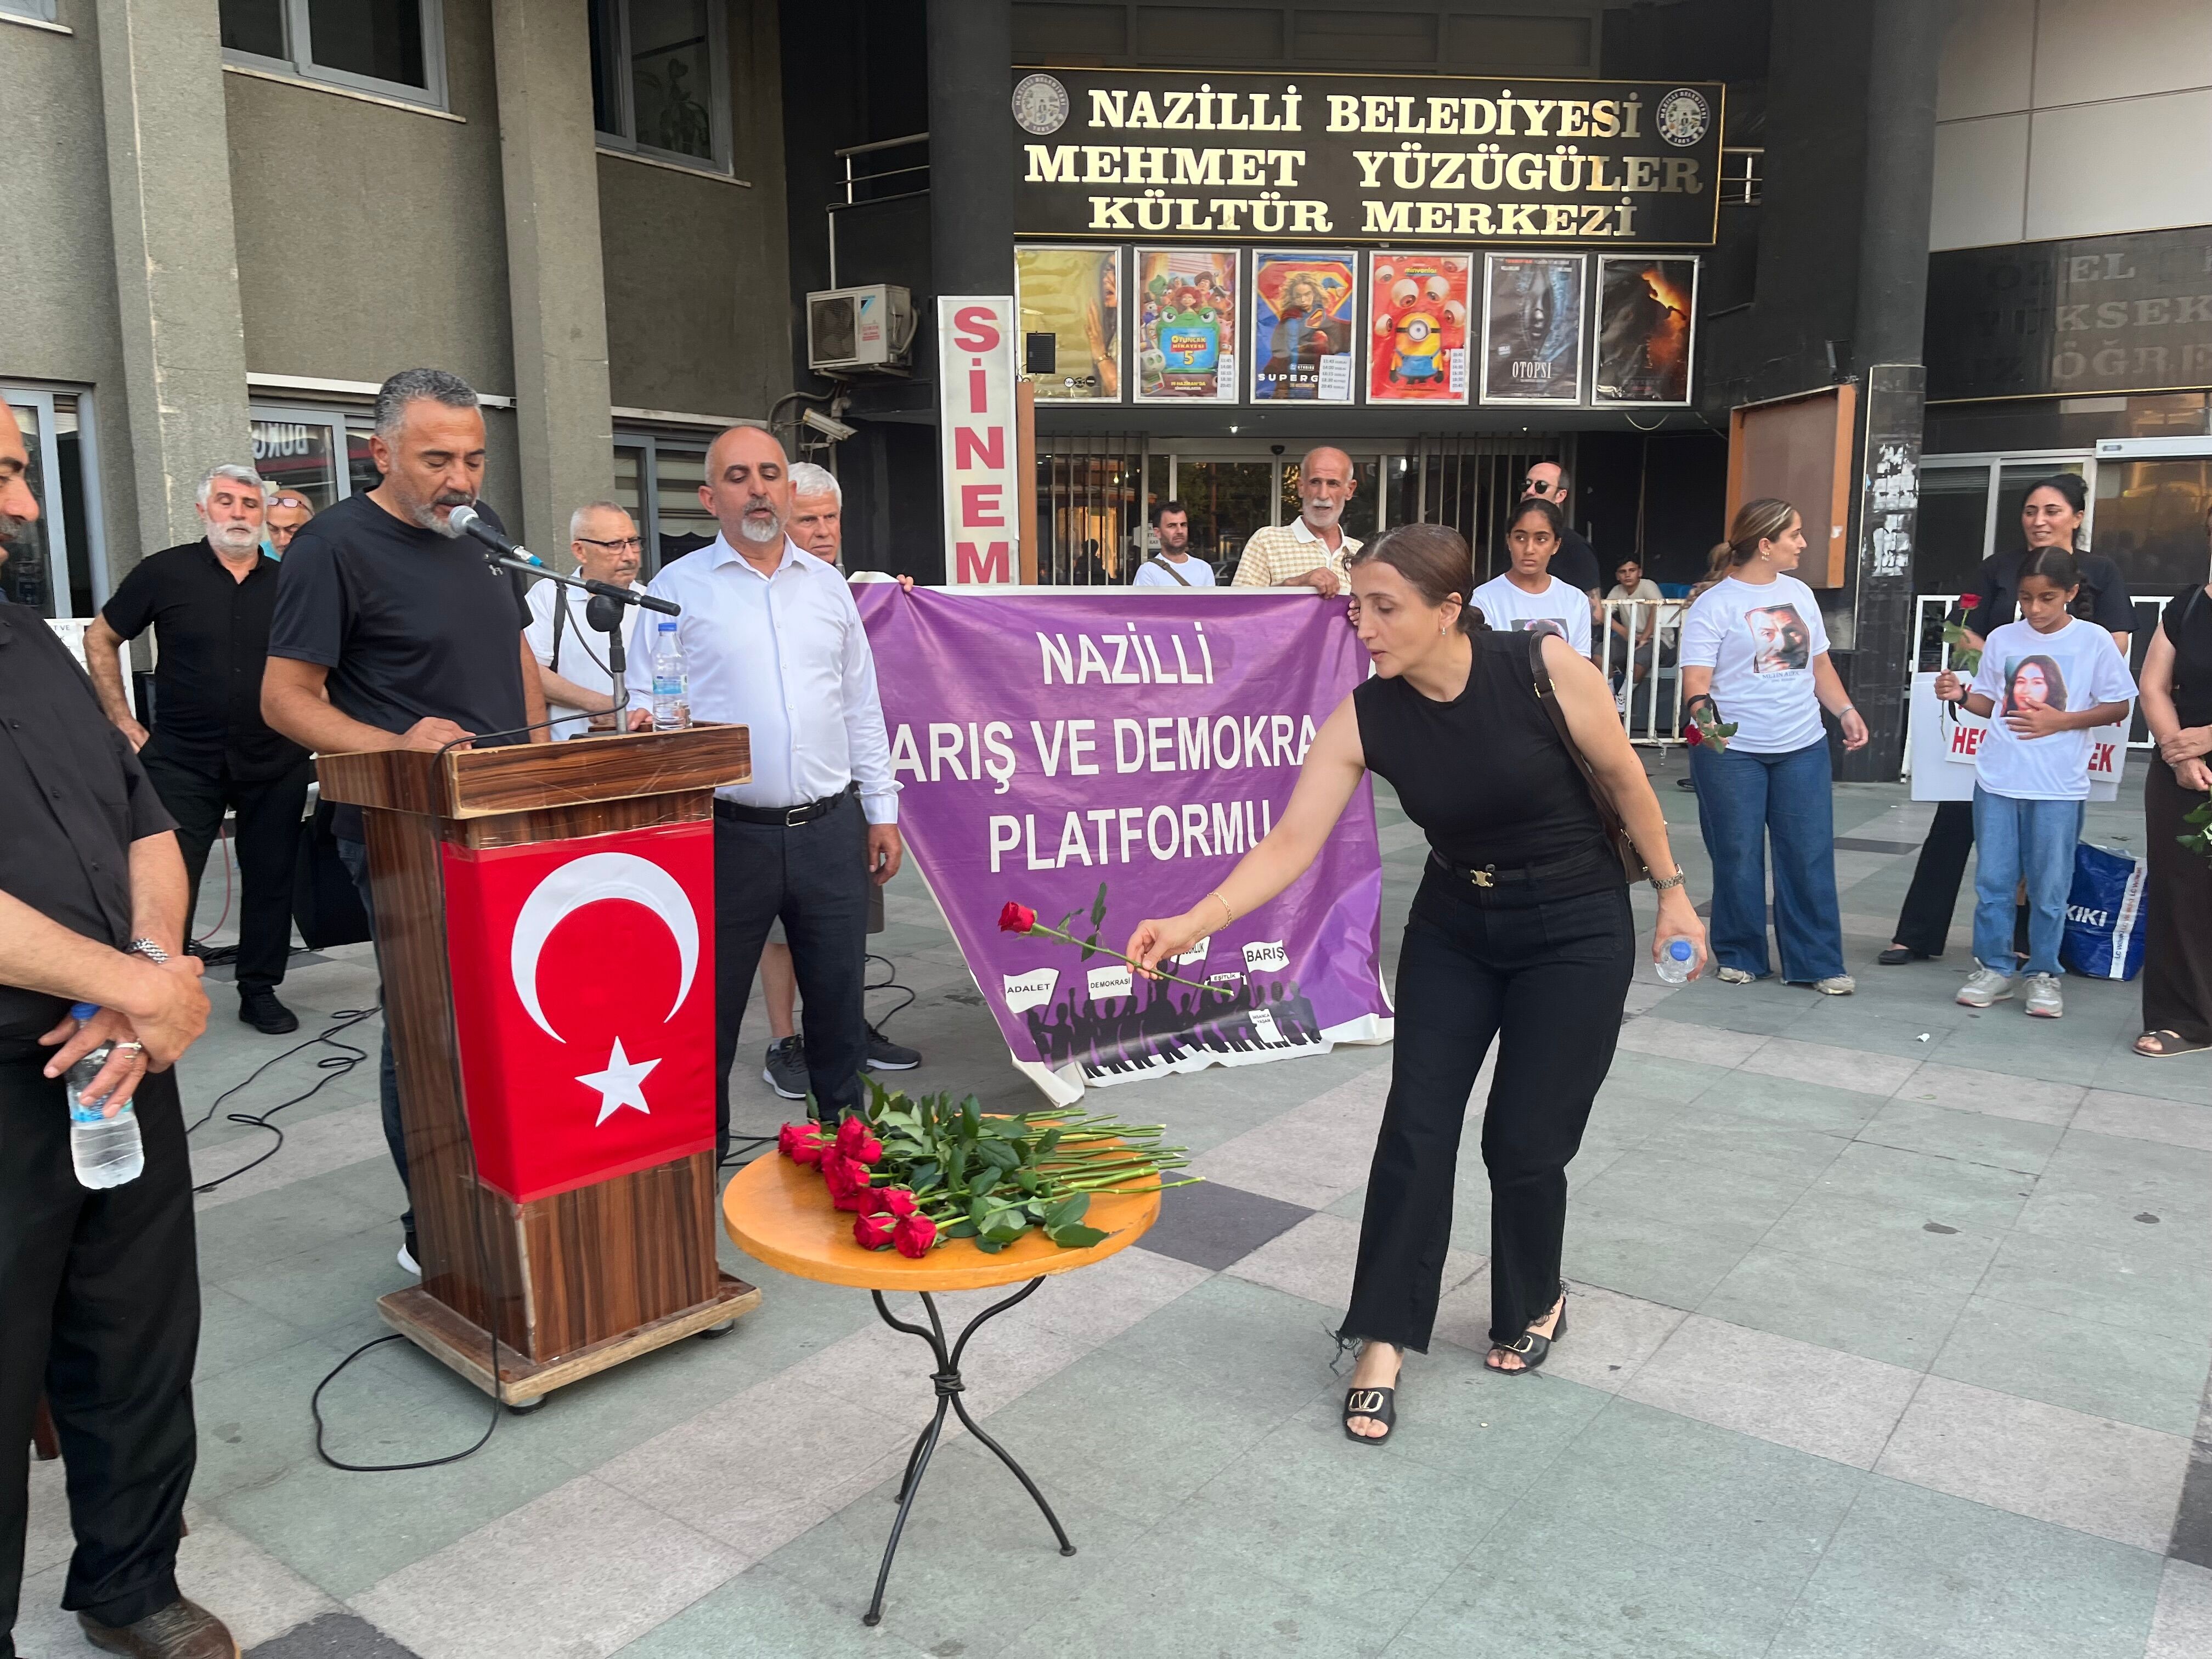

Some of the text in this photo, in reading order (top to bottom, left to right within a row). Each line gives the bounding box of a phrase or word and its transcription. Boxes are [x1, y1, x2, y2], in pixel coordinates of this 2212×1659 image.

[1088, 84, 1641, 139] NAZİLLİ BELEDİYESİ
[1024, 142, 1703, 194] MEHMET YÜZÜGÜLER
[1088, 189, 1638, 236] KÜLTÜR MERKEZİ
[1184, 350, 1194, 365] 5
[1258, 374, 1318, 382] SUPERG
[953, 306, 1010, 584] SİNEM
[1036, 621, 1214, 685] NAZİLLİ
[891, 714, 1317, 795] ARIŞ VE DEMOKRA
[1246, 946, 1285, 963] BARIŞ
[1007, 983, 1051, 994] ADALET
[1090, 977, 1131, 989] DEMOKRASİ
[1214, 973, 1236, 981] EŞİTLİK
